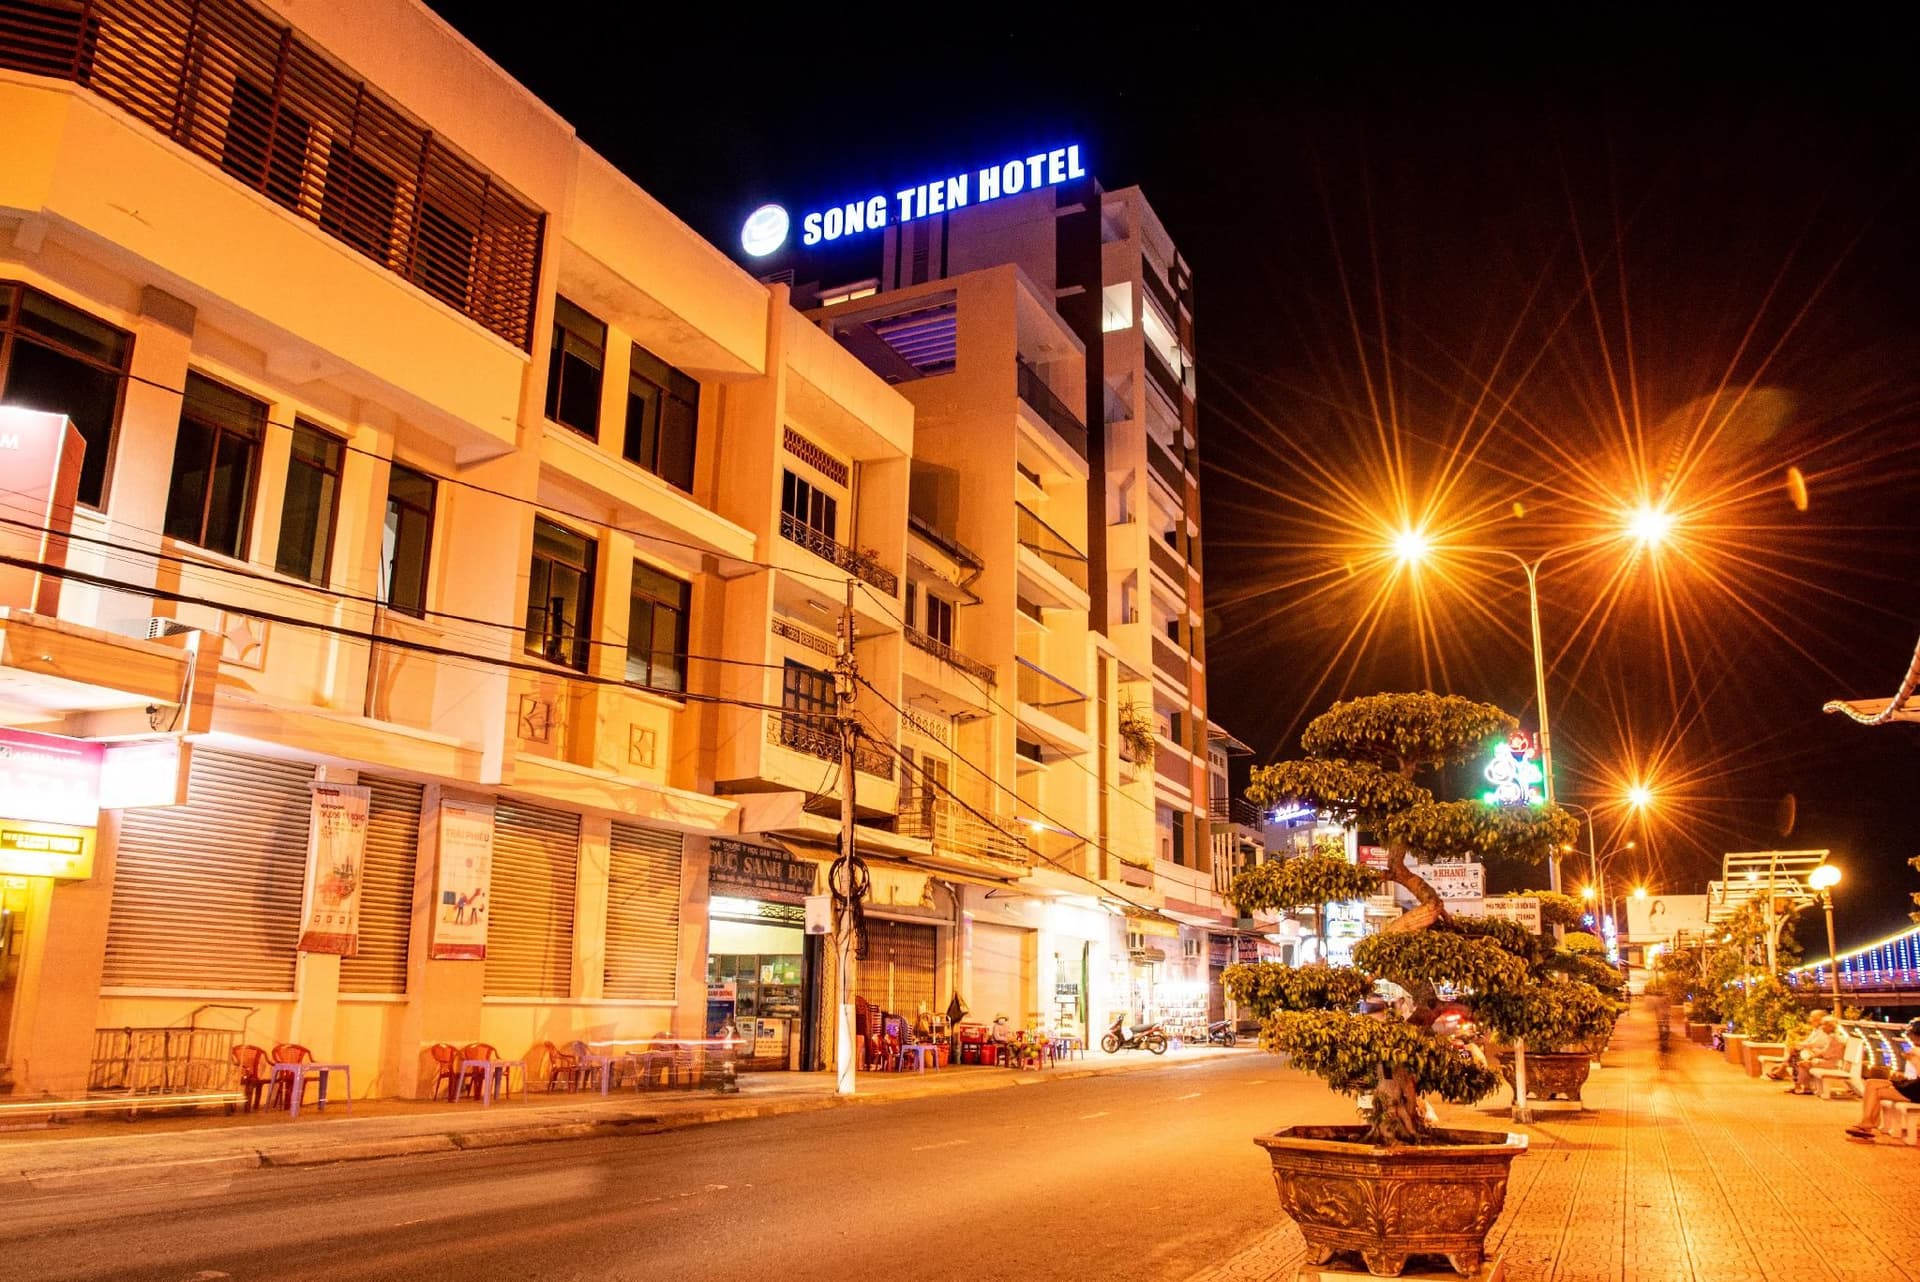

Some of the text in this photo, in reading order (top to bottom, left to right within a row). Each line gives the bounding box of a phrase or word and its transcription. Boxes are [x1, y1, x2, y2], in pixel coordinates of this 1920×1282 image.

[803, 144, 1085, 246] SONG TIEN HOTEL
[743, 856, 781, 878] SANH
